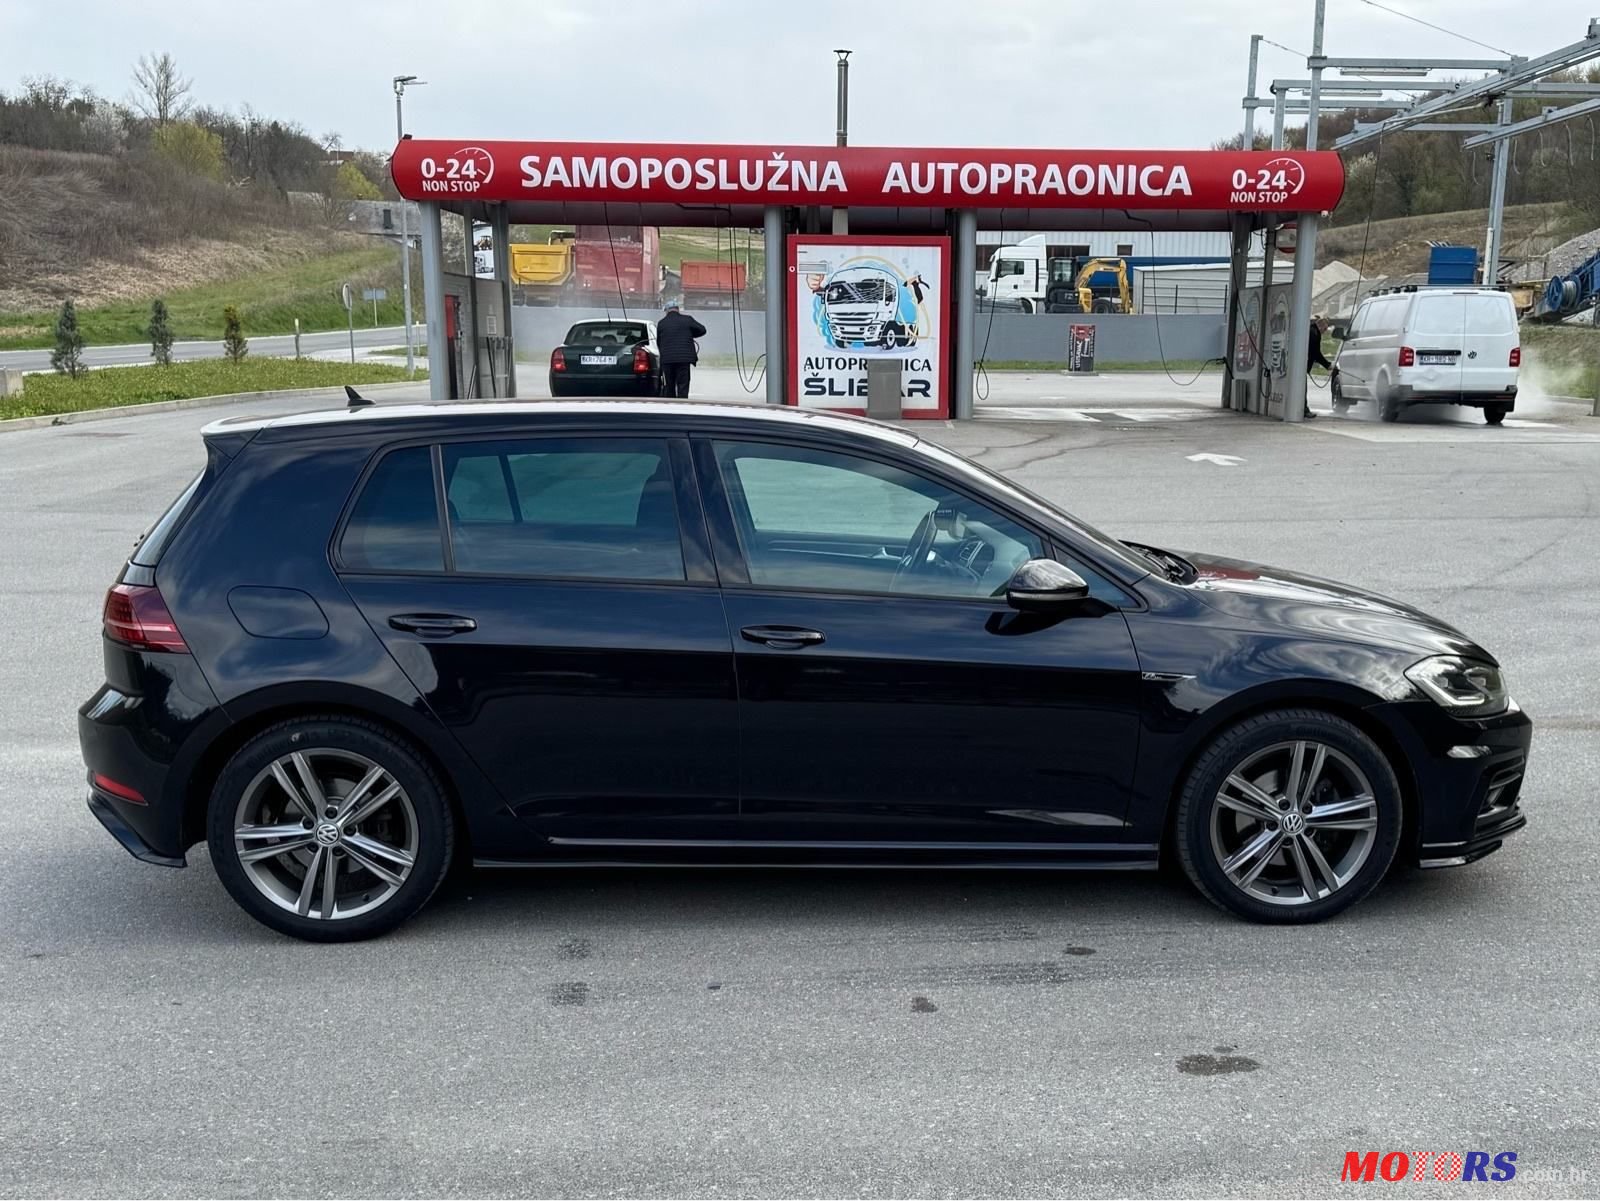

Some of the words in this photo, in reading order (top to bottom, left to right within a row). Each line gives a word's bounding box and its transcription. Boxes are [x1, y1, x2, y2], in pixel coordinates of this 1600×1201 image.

[421, 158, 477, 178] 0-24
[520, 151, 847, 192] SAMOPOSLUŽNA
[882, 161, 1193, 196] AUTOPRAONICA
[422, 180, 448, 192] NON
[450, 180, 480, 192] STOP
[1232, 169, 1287, 189] 0-24
[1230, 191, 1256, 203] NON
[1258, 191, 1288, 203] STOP
[804, 357, 932, 372] AUTOPRICA
